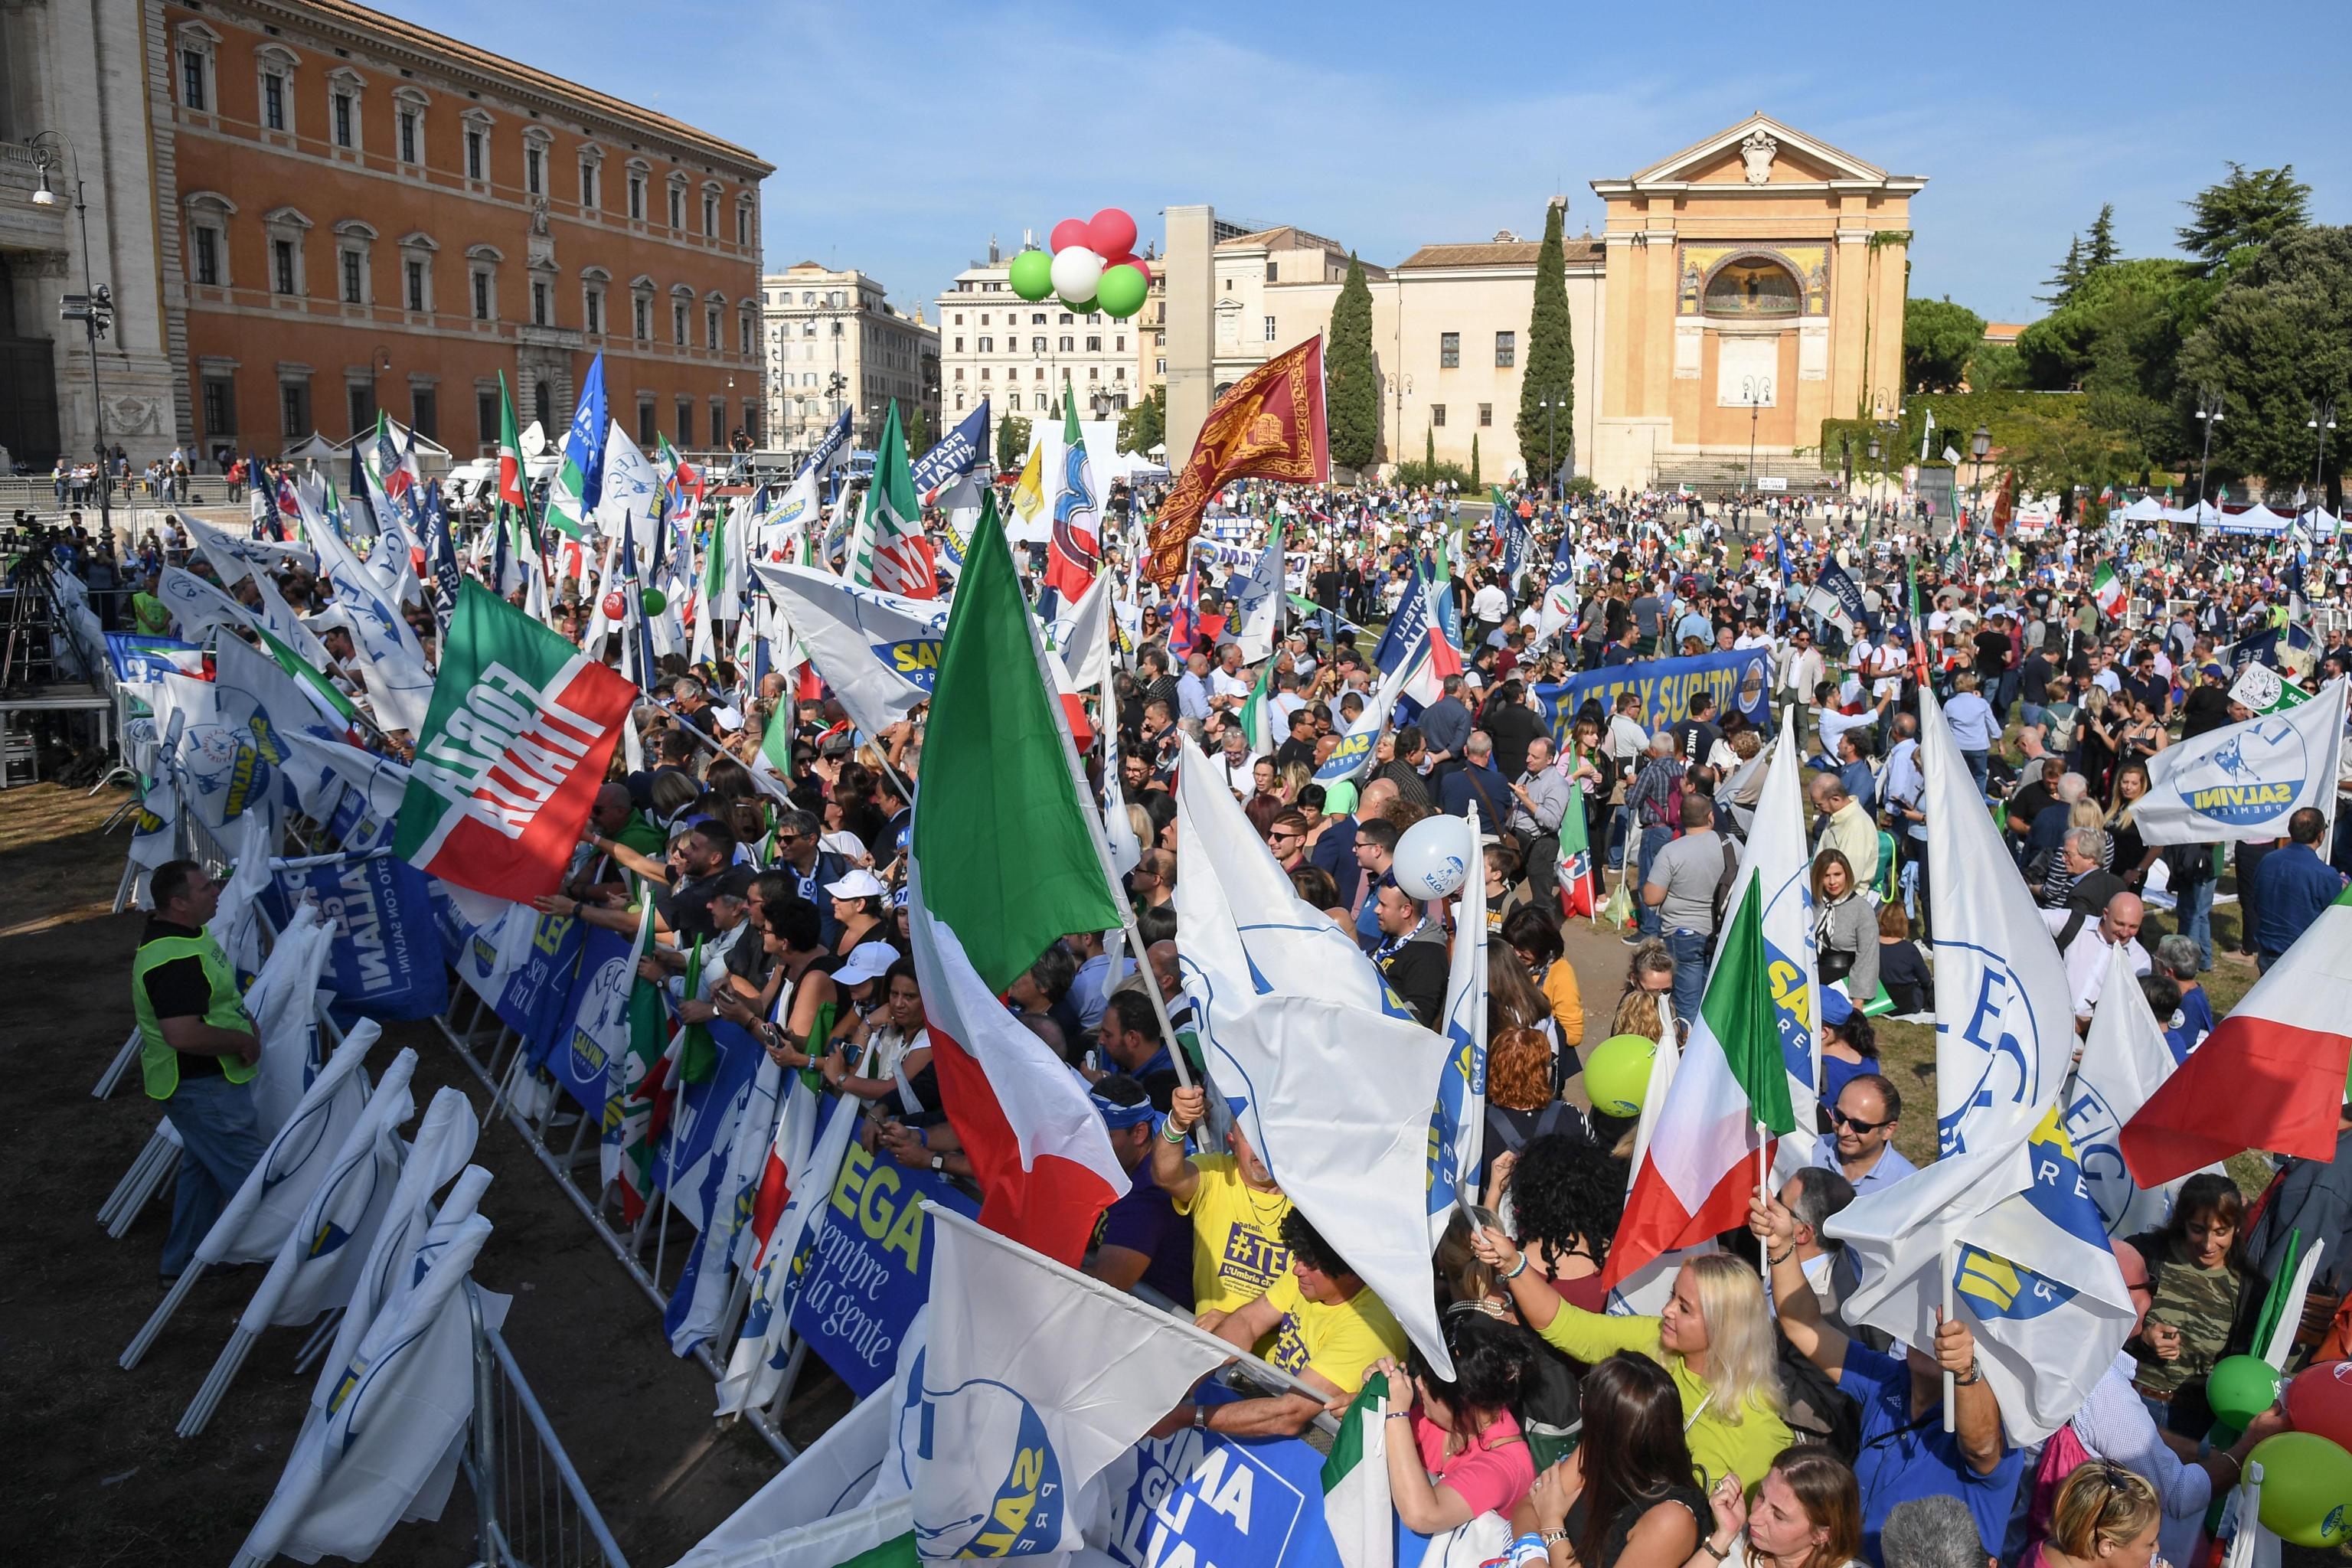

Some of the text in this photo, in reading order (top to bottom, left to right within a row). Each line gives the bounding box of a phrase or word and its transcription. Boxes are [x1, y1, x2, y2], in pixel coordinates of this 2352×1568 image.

[945, 524, 973, 561] SALV
[1687, 728, 1698, 757] NIKE
[1425, 872, 1446, 894] VOTA
[574, 1031, 606, 1070] SALVINI
[831, 1139, 927, 1276] EGA
[817, 1216, 890, 1302] sempre
[1223, 1265, 1272, 1288] L'Umbria ch
[805, 1260, 892, 1368] la gente
[1137, 1427, 1254, 1536] IMA
[1141, 1465, 1196, 1535] GLI
